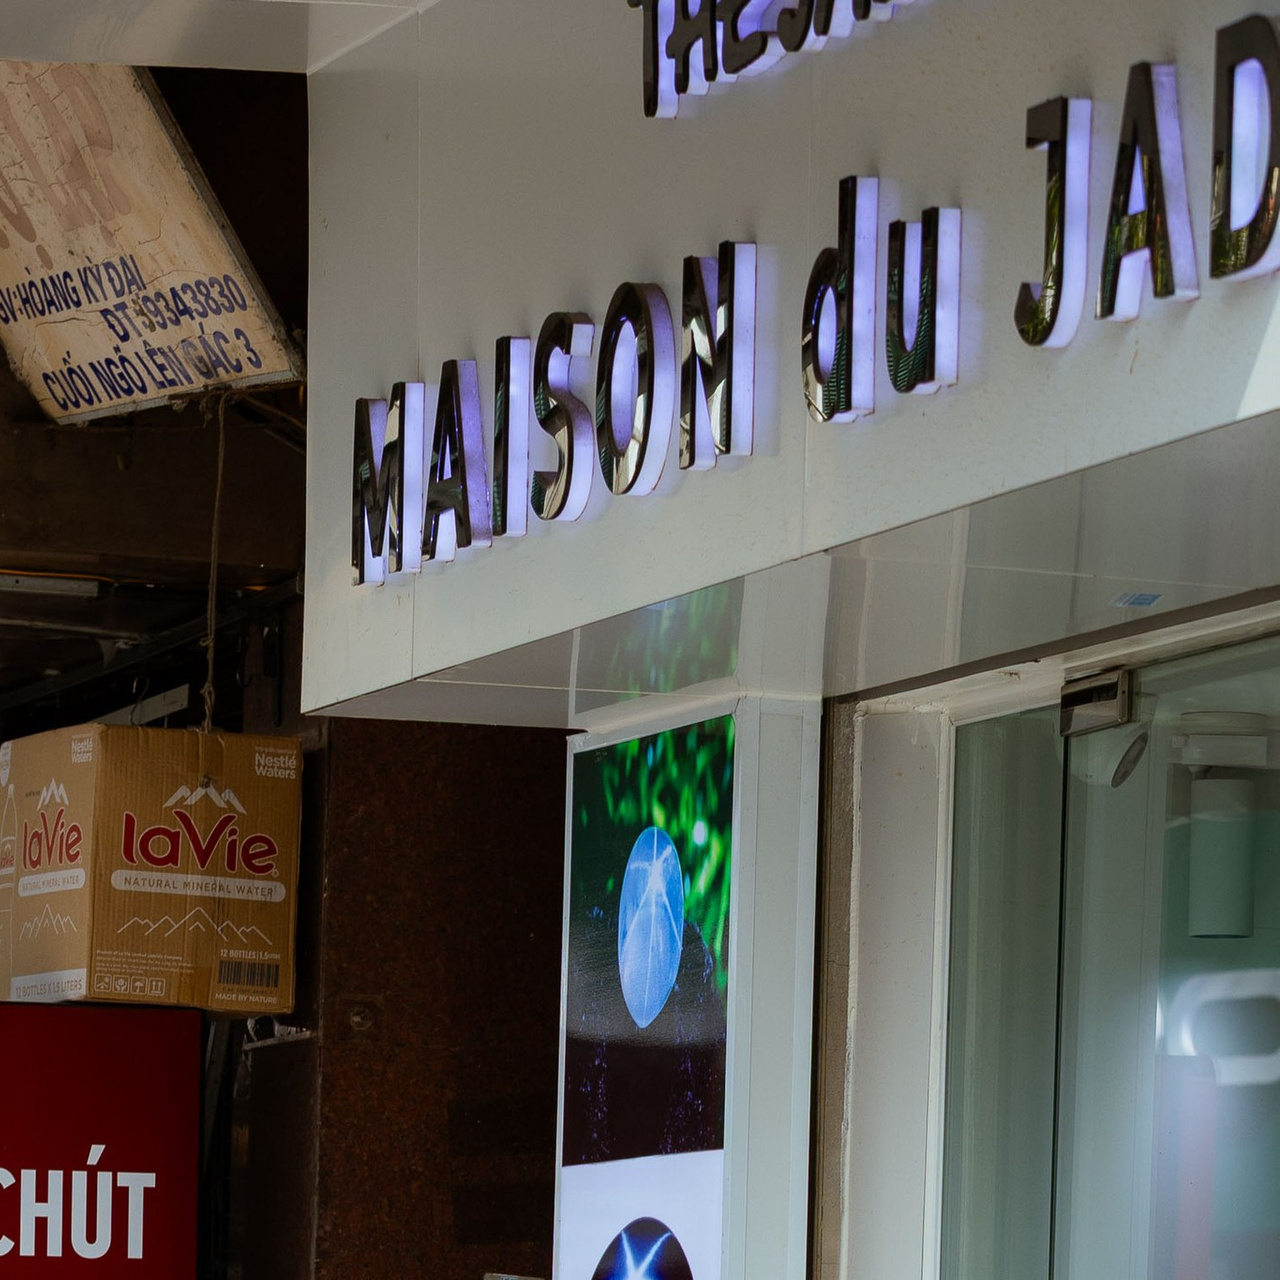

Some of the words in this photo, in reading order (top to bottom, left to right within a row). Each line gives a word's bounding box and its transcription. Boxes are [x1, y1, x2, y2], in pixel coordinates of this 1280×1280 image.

[42, 351, 93, 410] CUỐI
[89, 345, 148, 404] NGÕ
[135, 340, 194, 390] LÊN
[181, 322, 242, 380] GÁC
[234, 328, 262, 369] 3
[352, 241, 757, 585] MAISON
[802, 176, 961, 422] du
[255, 753, 297, 769] Nestlé
[255, 766, 296, 780] Waters
[122, 809, 279, 876] laVie
[124, 876, 178, 889] NATURAL
[183, 880, 231, 893] MINERAL
[236, 884, 274, 897] WATER
[215, 993, 237, 1001] MADE
[237, 994, 248, 1002] BY
[249, 996, 278, 1004] NATURE
